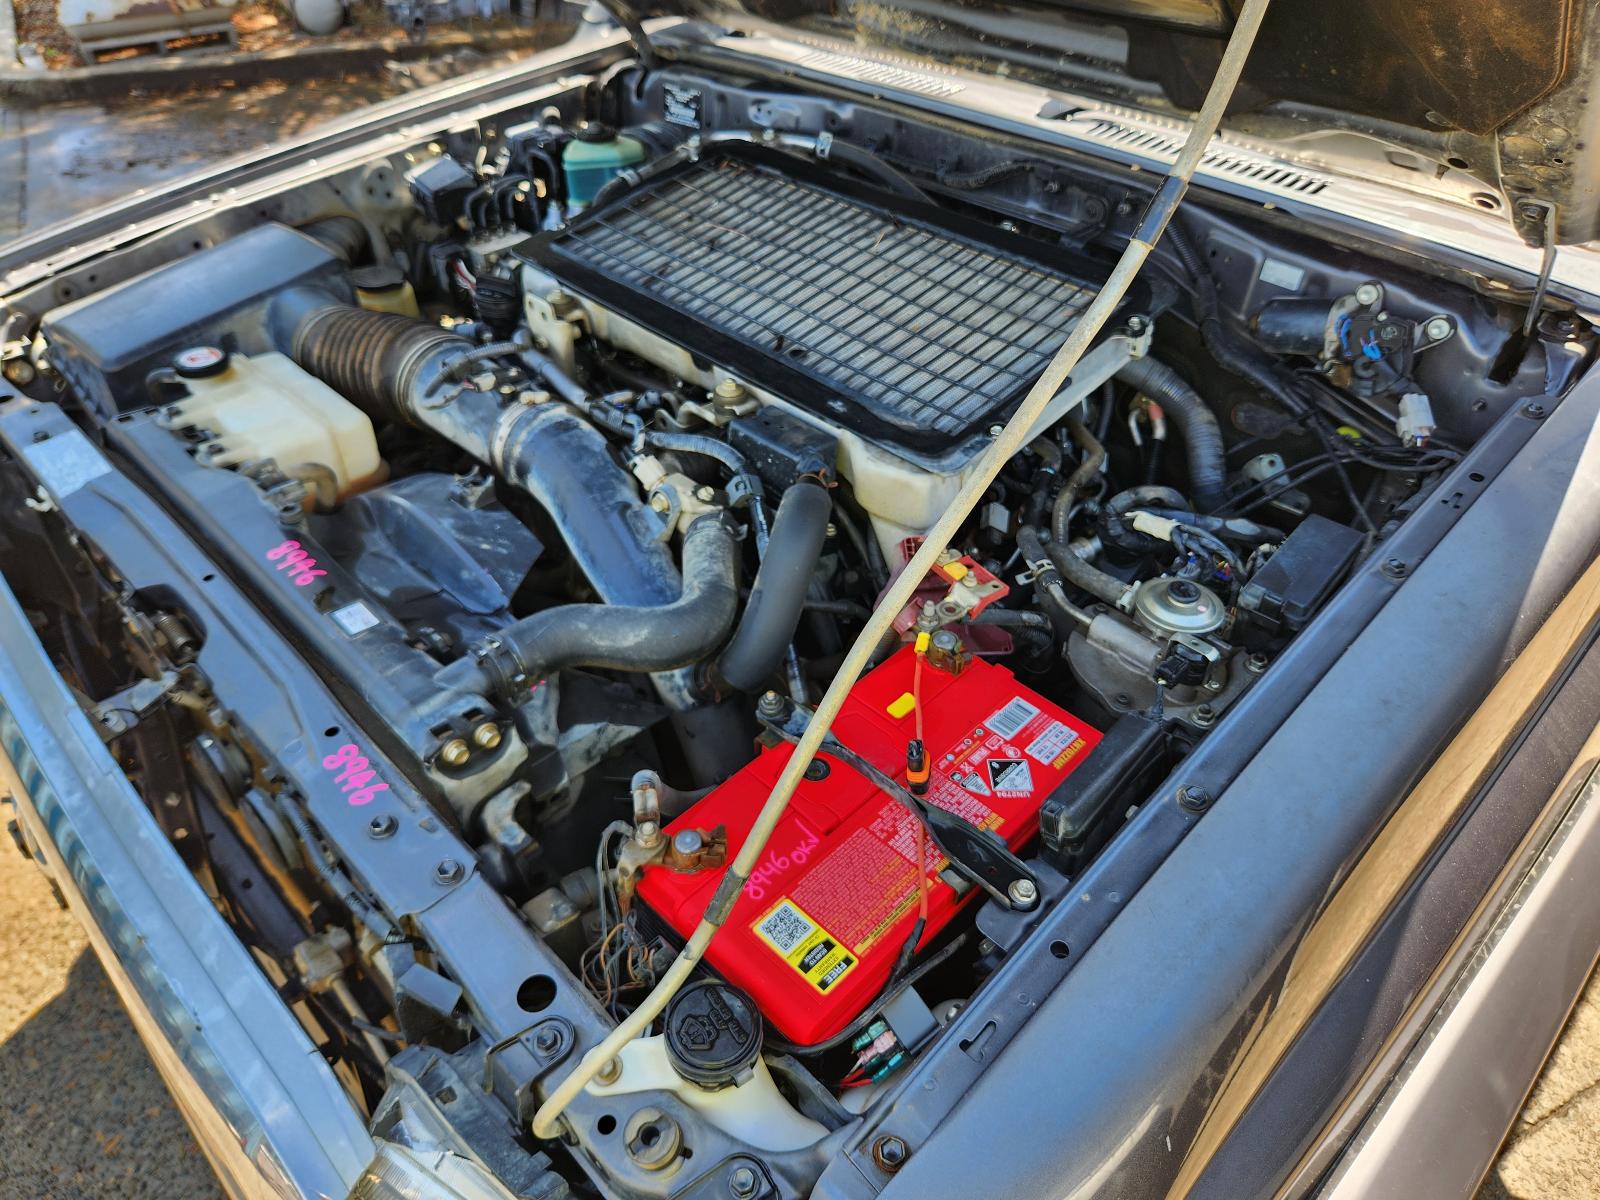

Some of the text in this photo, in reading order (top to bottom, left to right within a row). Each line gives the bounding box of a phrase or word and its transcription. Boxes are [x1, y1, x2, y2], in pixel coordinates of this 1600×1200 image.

[323, 743, 390, 807] 8946
[744, 850, 790, 899] 8946
[803, 942, 825, 963] REGISTER
[822, 960, 847, 984] FREE
